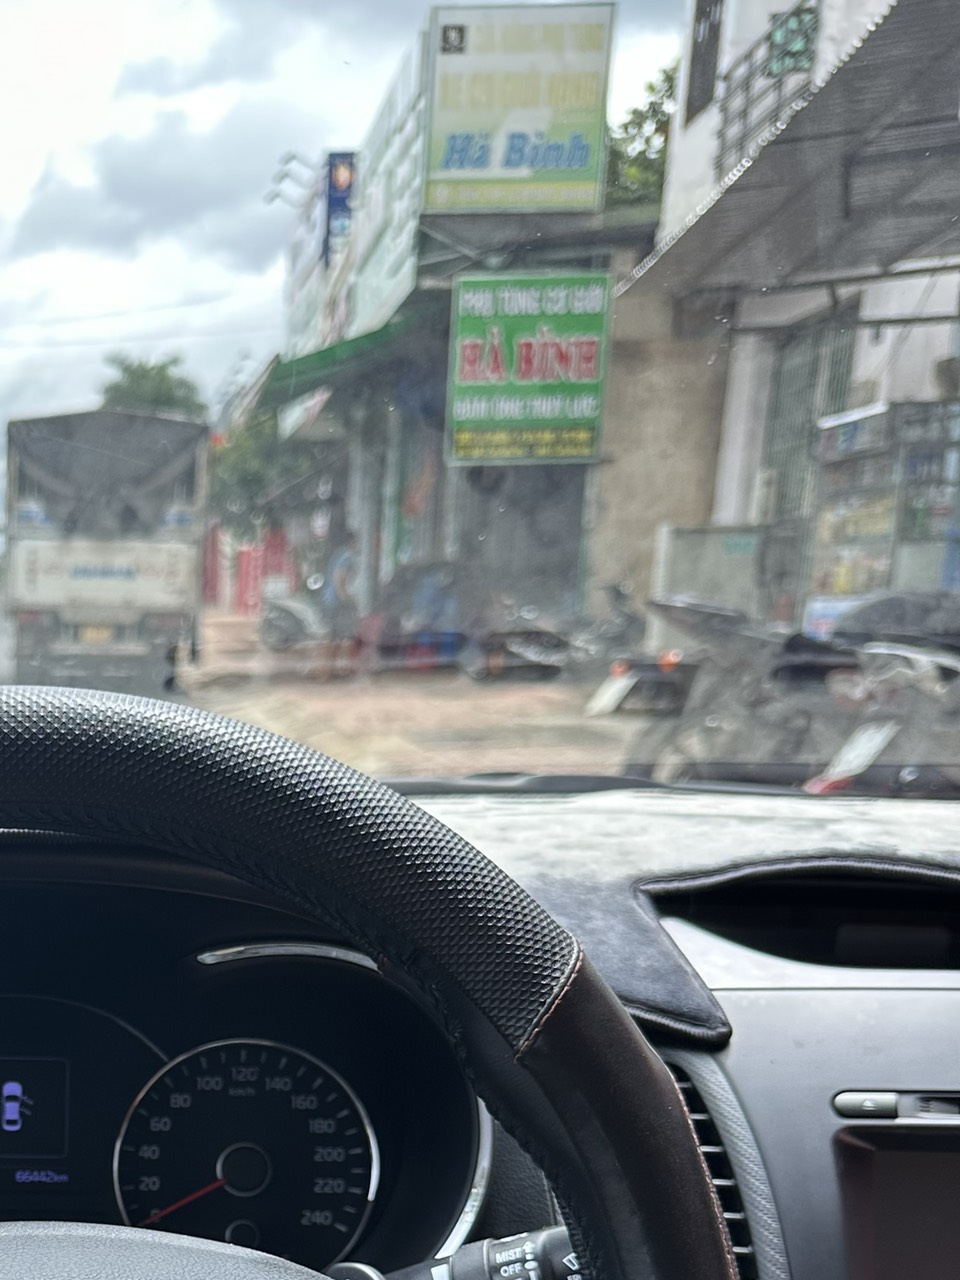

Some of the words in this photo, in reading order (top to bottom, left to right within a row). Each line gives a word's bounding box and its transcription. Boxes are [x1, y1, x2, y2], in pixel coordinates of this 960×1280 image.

[457, 326, 506, 384] HÀ
[514, 325, 601, 383] BÌNH
[231, 1067, 259, 1082] 120
[196, 1076, 224, 1091] 100
[264, 1076, 292, 1091] 140
[169, 1094, 191, 1109] 80
[291, 1095, 318, 1110] 160
[150, 1117, 171, 1132] 60
[308, 1119, 336, 1134] 180
[138, 1146, 160, 1161] 40
[314, 1147, 346, 1163] 200
[139, 1177, 161, 1191] 20
[314, 1178, 346, 1194] 220
[300, 1210, 333, 1226] 240
[495, 1249, 523, 1264] MIST
[500, 1263, 523, 1277] OFF
